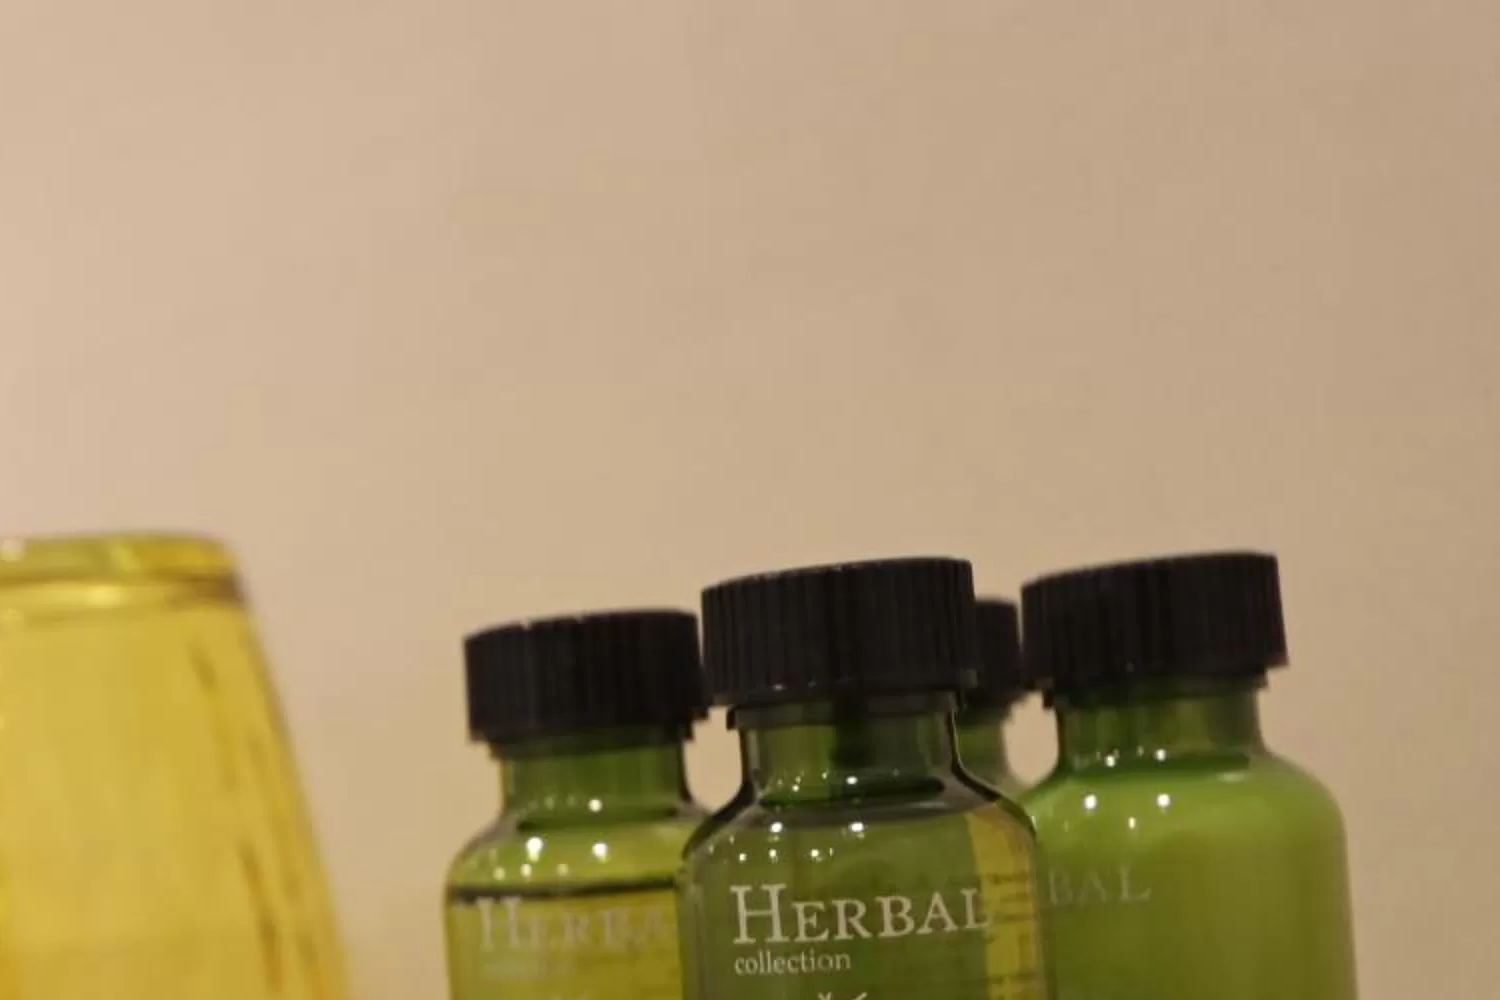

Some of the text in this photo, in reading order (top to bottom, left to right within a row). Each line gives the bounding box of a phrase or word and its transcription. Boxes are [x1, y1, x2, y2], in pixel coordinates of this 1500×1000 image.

[1048, 866, 1152, 905] BAL
[475, 896, 670, 951] HERBA
[729, 883, 990, 944] HERBAL
[734, 949, 851, 975] collection
